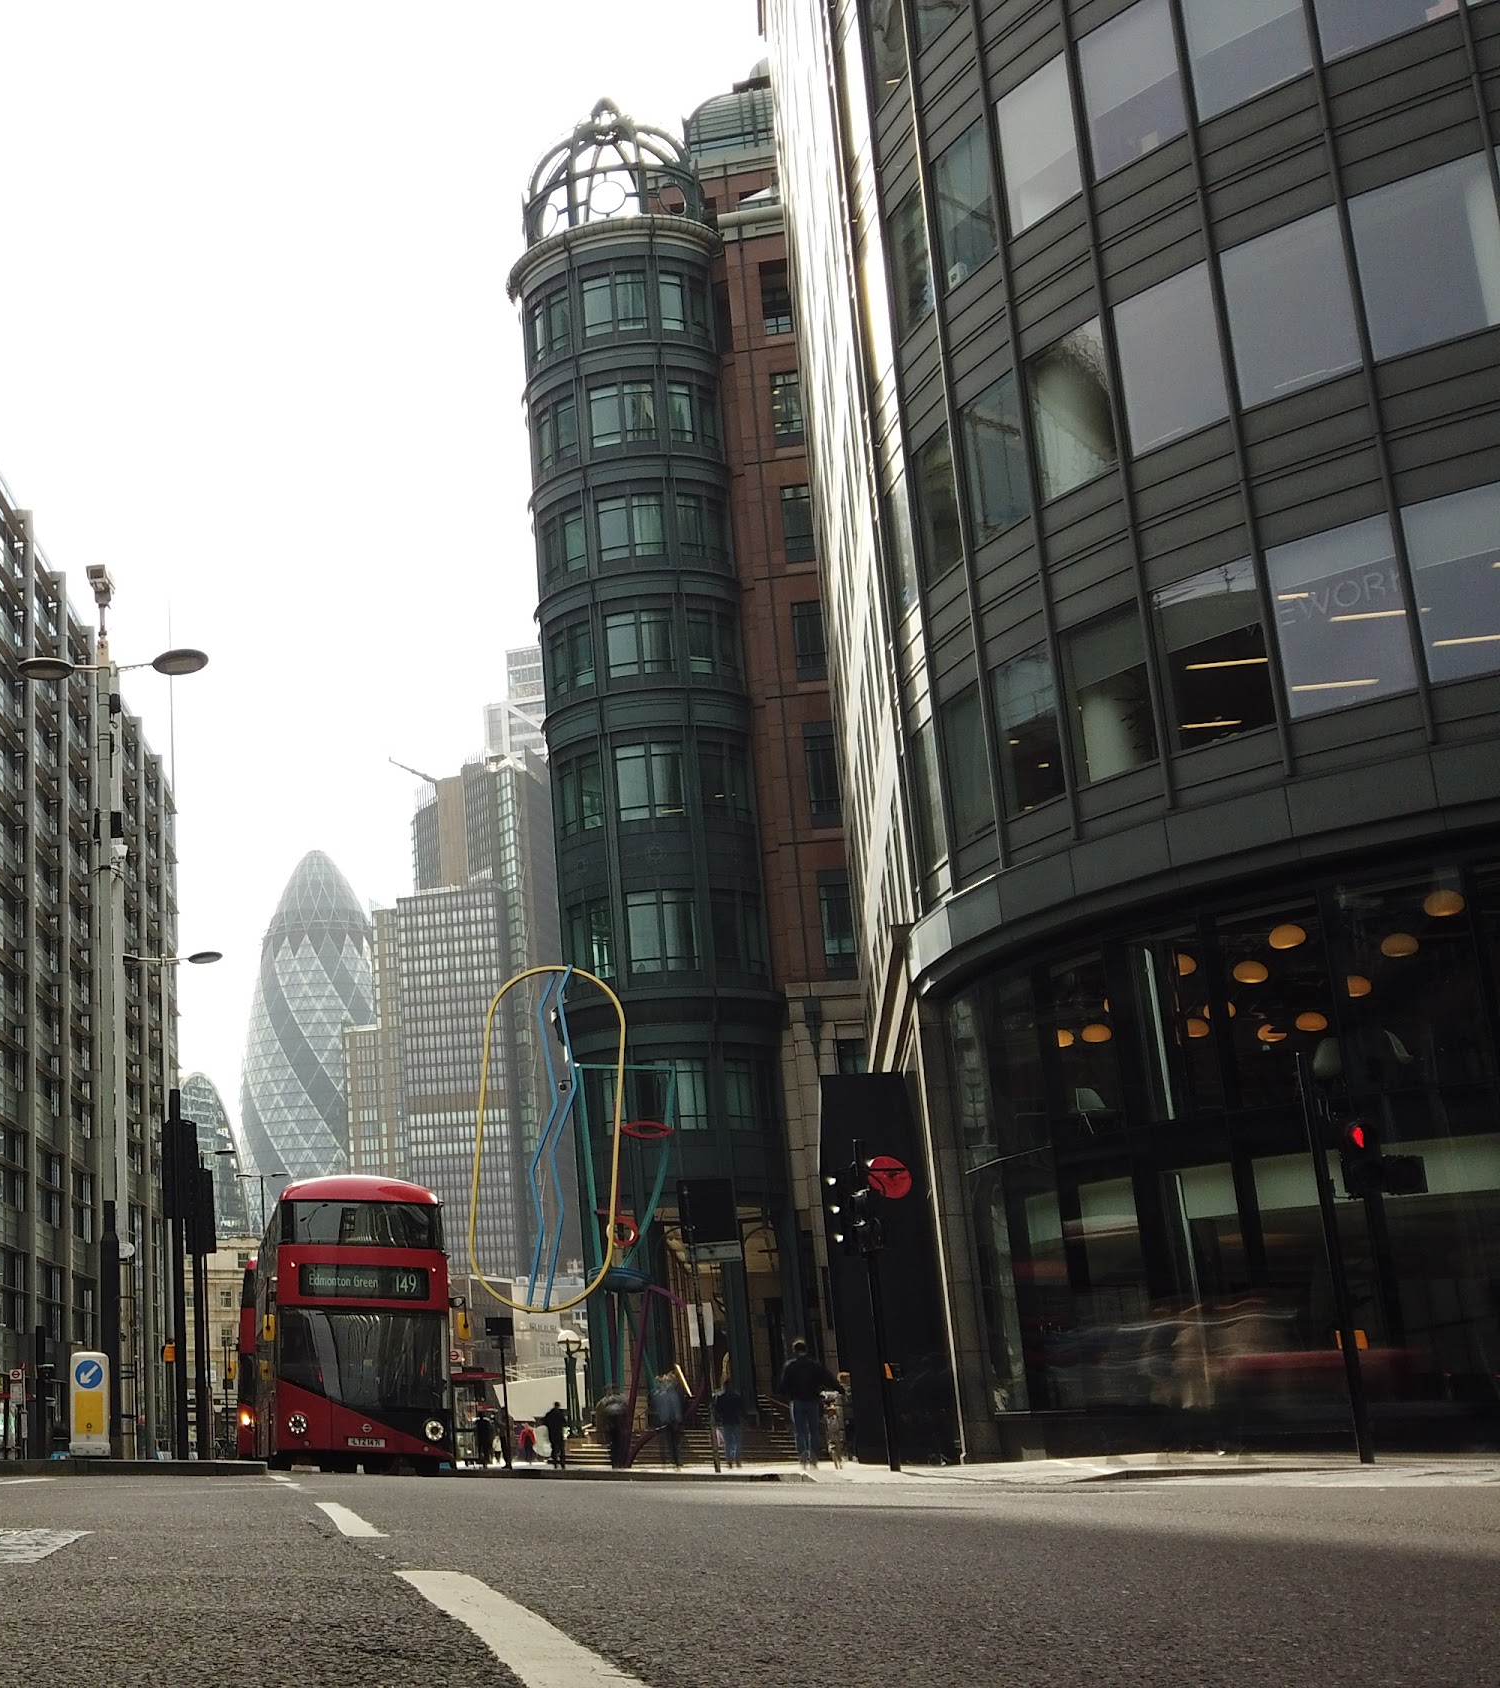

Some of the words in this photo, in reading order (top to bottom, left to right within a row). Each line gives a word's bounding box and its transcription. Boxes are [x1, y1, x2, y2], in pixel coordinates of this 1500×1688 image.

[308, 1274, 352, 1287] Edmonton
[353, 1275, 379, 1288] Green
[396, 1274, 417, 1292] 149
